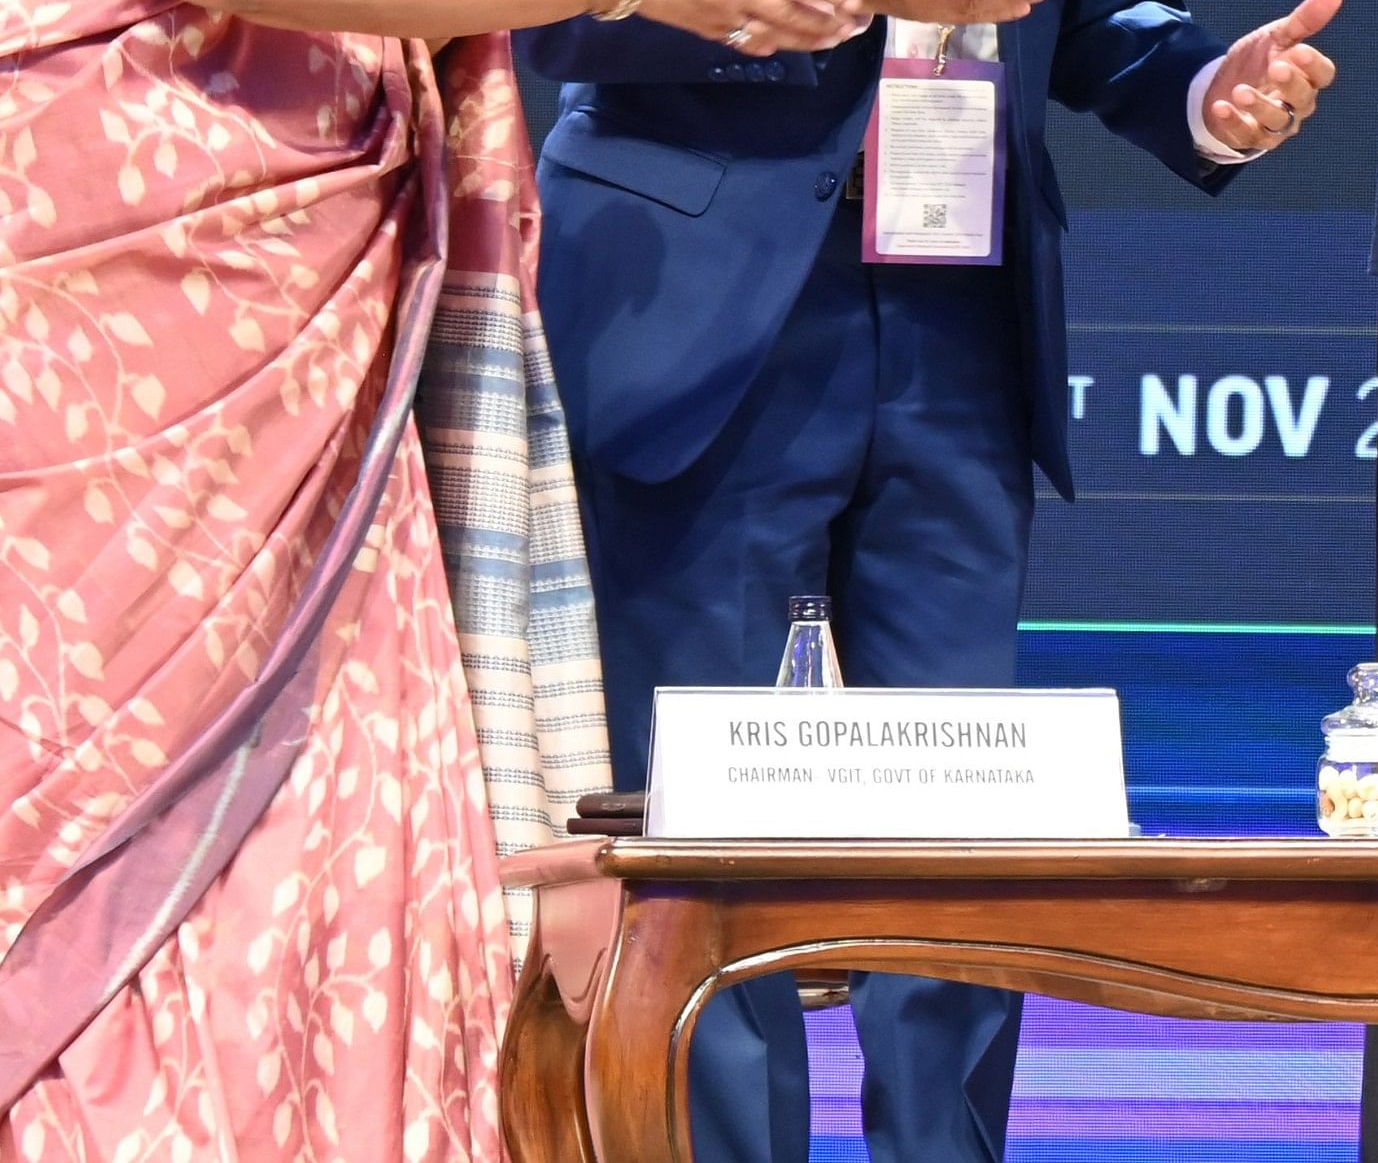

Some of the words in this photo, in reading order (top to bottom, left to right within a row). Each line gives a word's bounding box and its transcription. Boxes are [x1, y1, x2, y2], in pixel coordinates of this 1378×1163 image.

[1140, 374, 1330, 457] NOV
[730, 721, 788, 747] KRIS
[798, 721, 1027, 748] GOPALAKRISHNAN
[873, 768, 911, 784] GOVT
[919, 768, 937, 784] OF
[944, 768, 1035, 784] KARNATAKA
